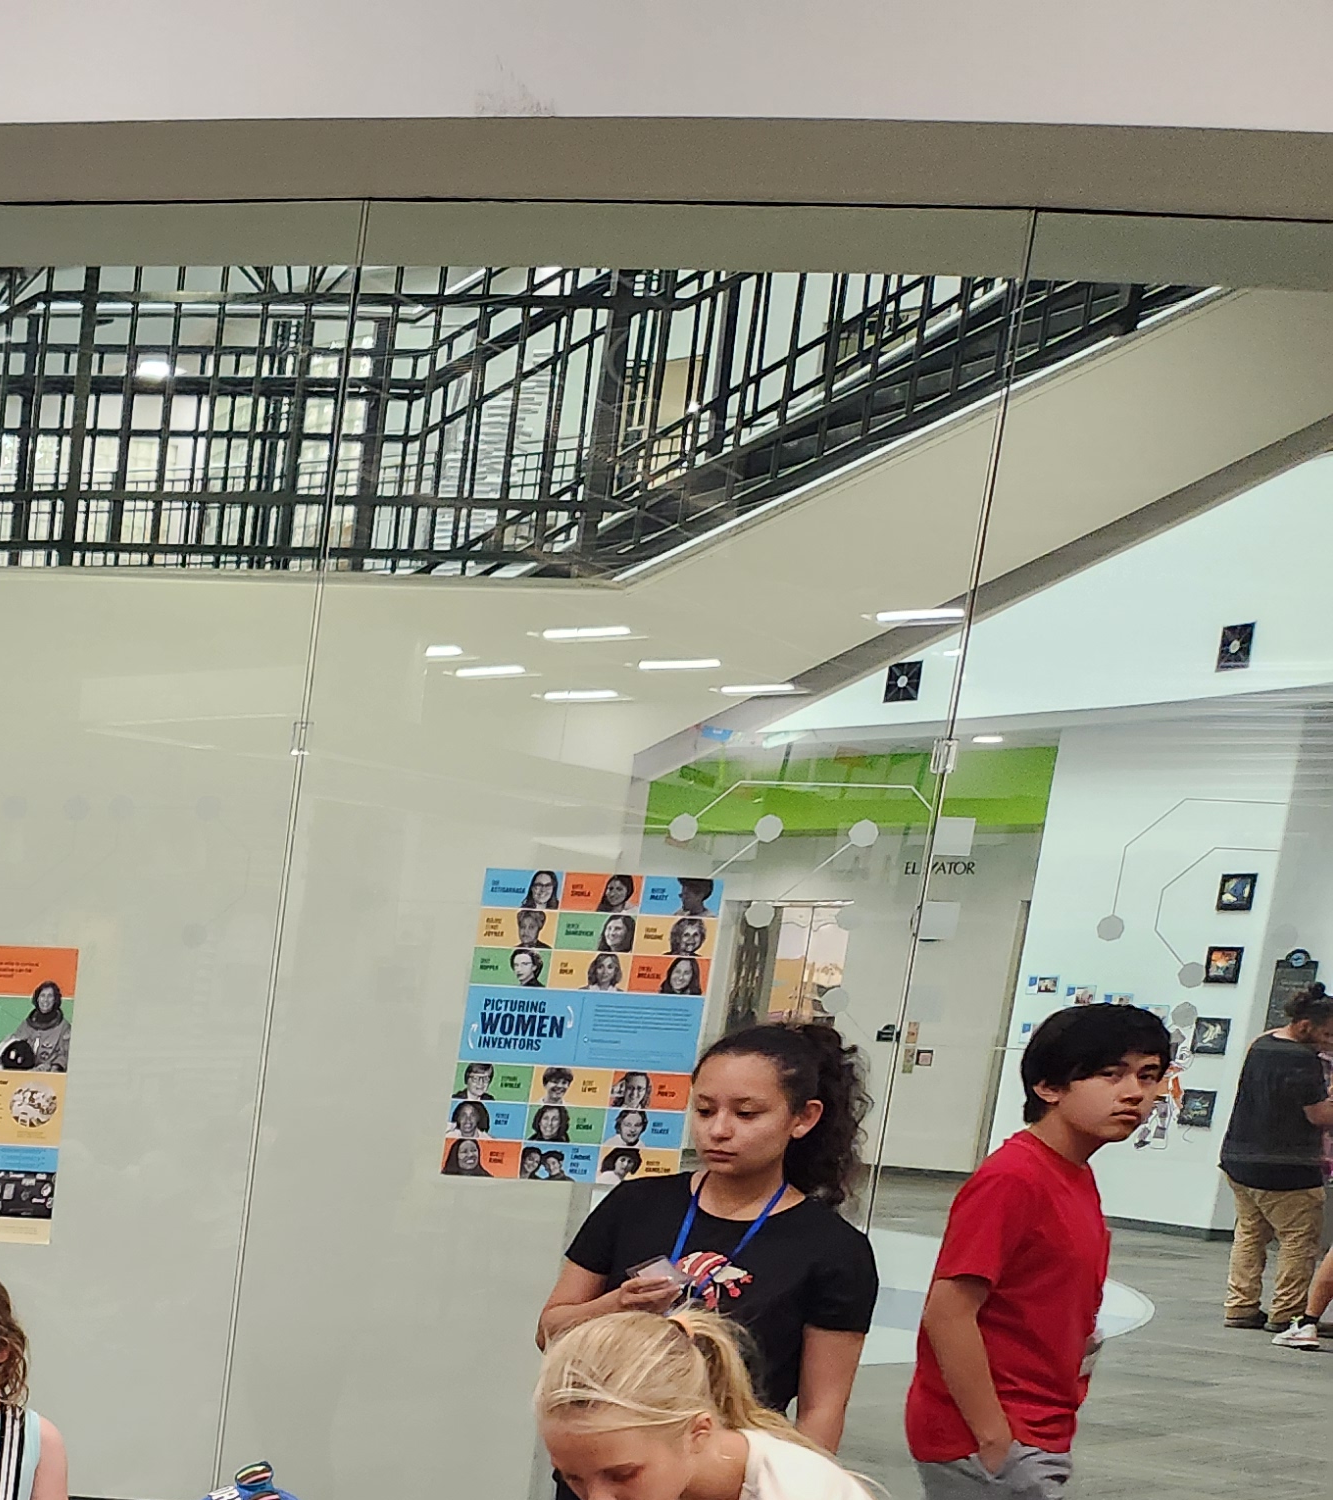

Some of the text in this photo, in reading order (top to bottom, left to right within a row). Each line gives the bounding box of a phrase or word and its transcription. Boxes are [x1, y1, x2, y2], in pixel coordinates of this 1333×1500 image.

[483, 998, 546, 1013] PICTURING
[480, 1012, 565, 1038] WOMEN
[478, 1036, 541, 1051] INVENTORS
